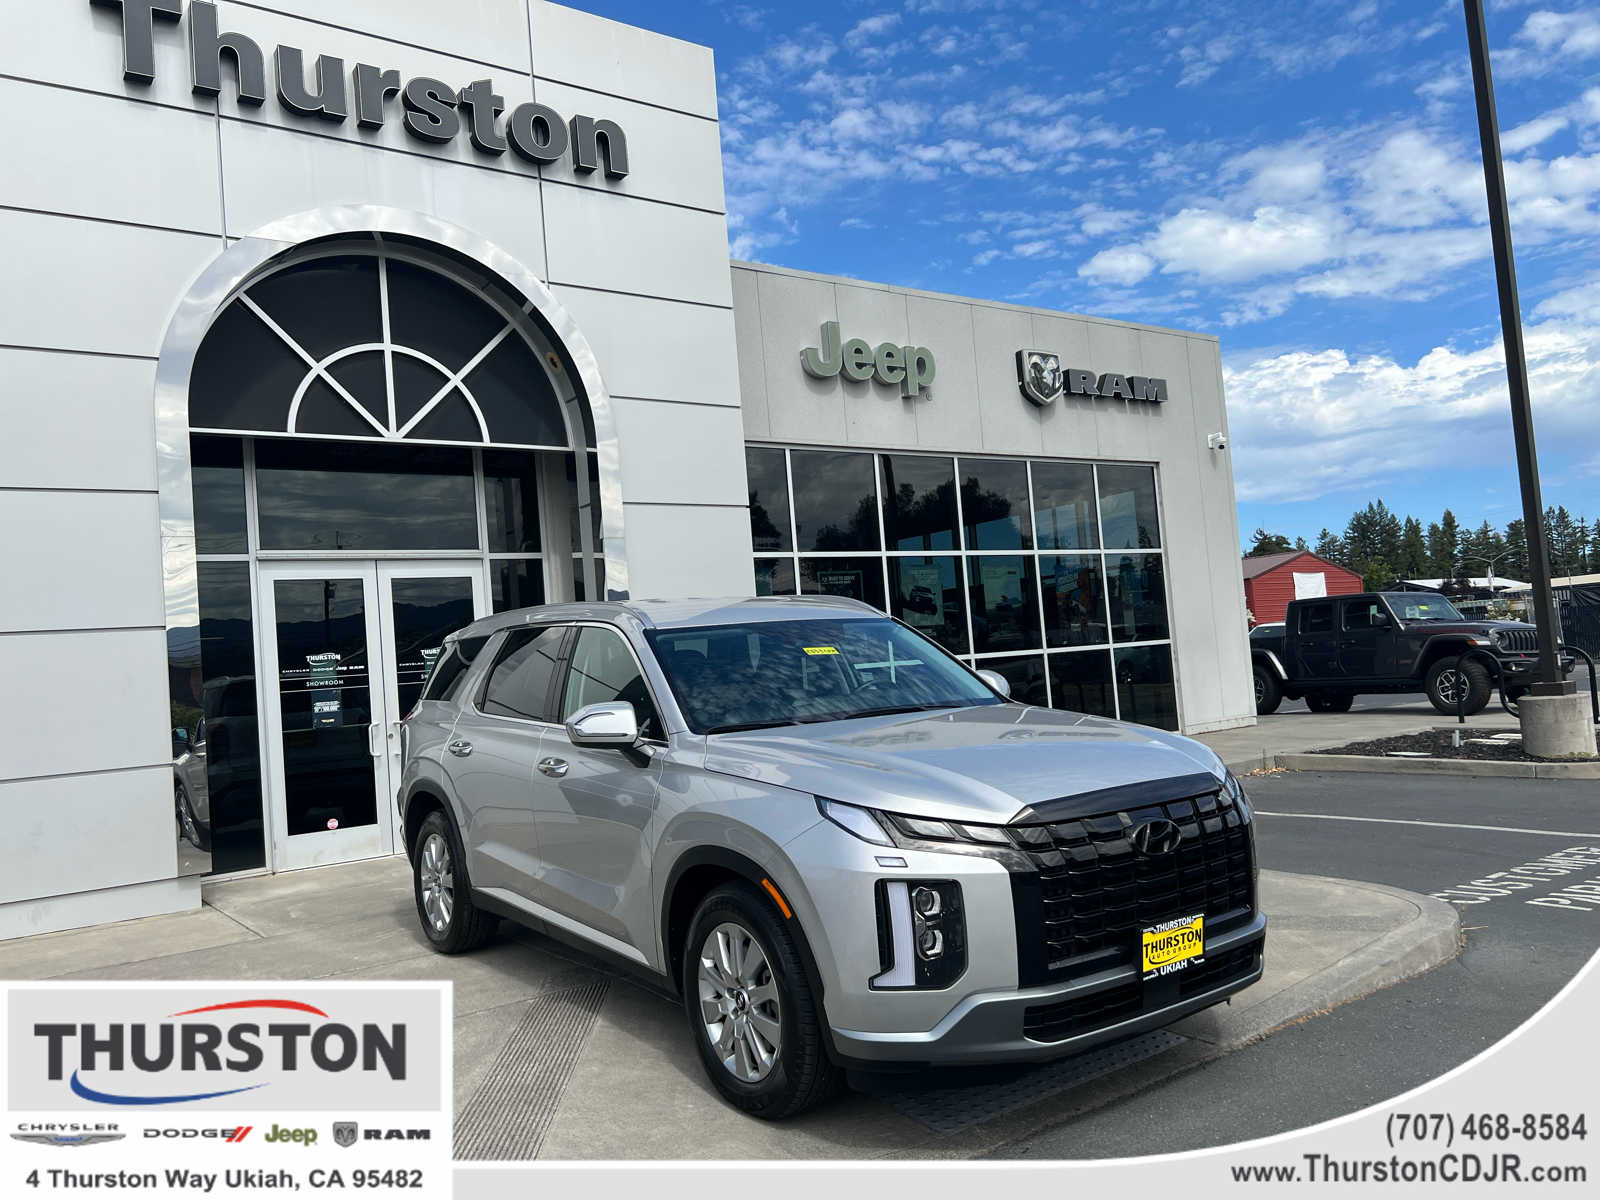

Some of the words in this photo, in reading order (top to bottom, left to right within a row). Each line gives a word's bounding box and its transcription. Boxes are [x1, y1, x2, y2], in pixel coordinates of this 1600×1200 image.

[90, 0, 630, 181] Thurston
[800, 320, 937, 400] Jeep
[1061, 368, 1169, 403] RAM
[305, 653, 341, 662] THURSTON
[305, 679, 344, 687] SHOWROOM
[1156, 916, 1192, 932] THURSTON
[1144, 928, 1202, 958] THURSTON
[1160, 959, 1187, 975] UKIAH
